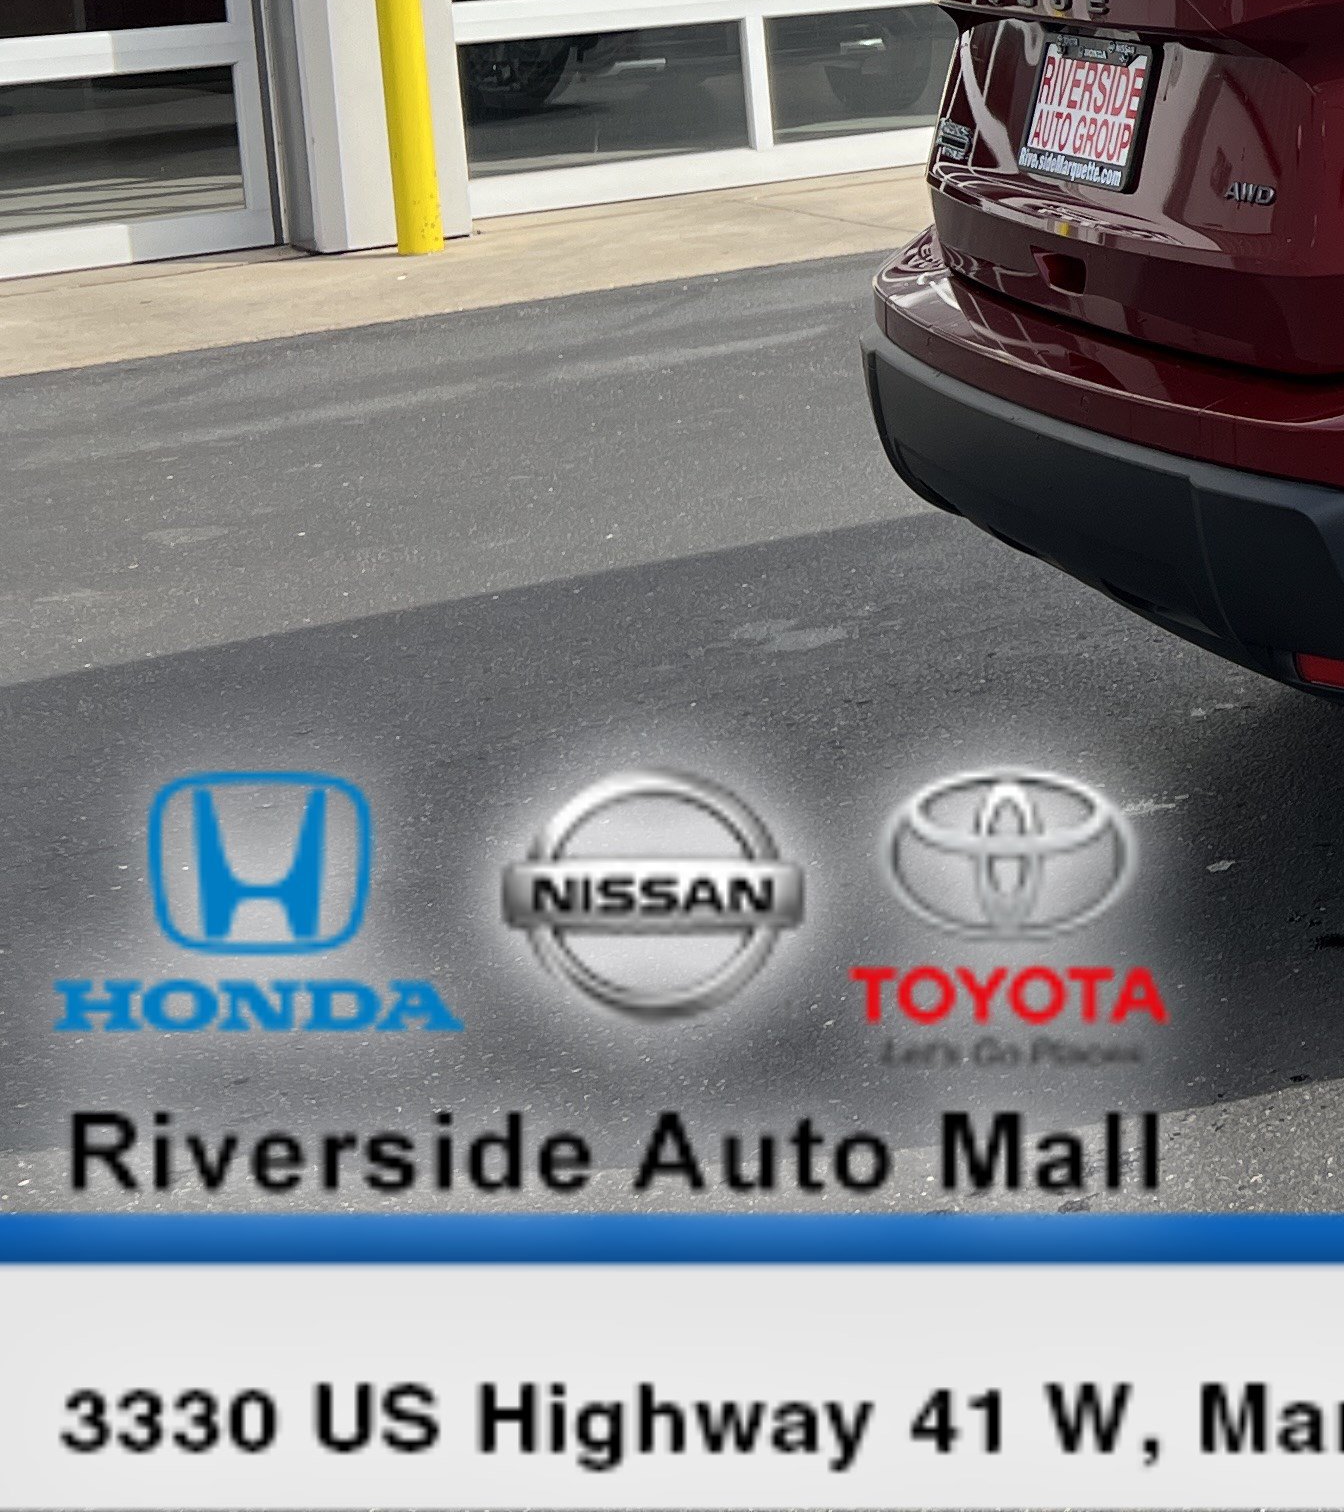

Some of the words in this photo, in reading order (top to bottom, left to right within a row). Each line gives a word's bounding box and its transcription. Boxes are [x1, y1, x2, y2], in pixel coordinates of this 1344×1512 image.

[1038, 55, 1147, 120] RIVERSIDE
[1030, 109, 1073, 152] AUTO
[1072, 114, 1133, 163] GROUP
[1223, 180, 1276, 205] AWD
